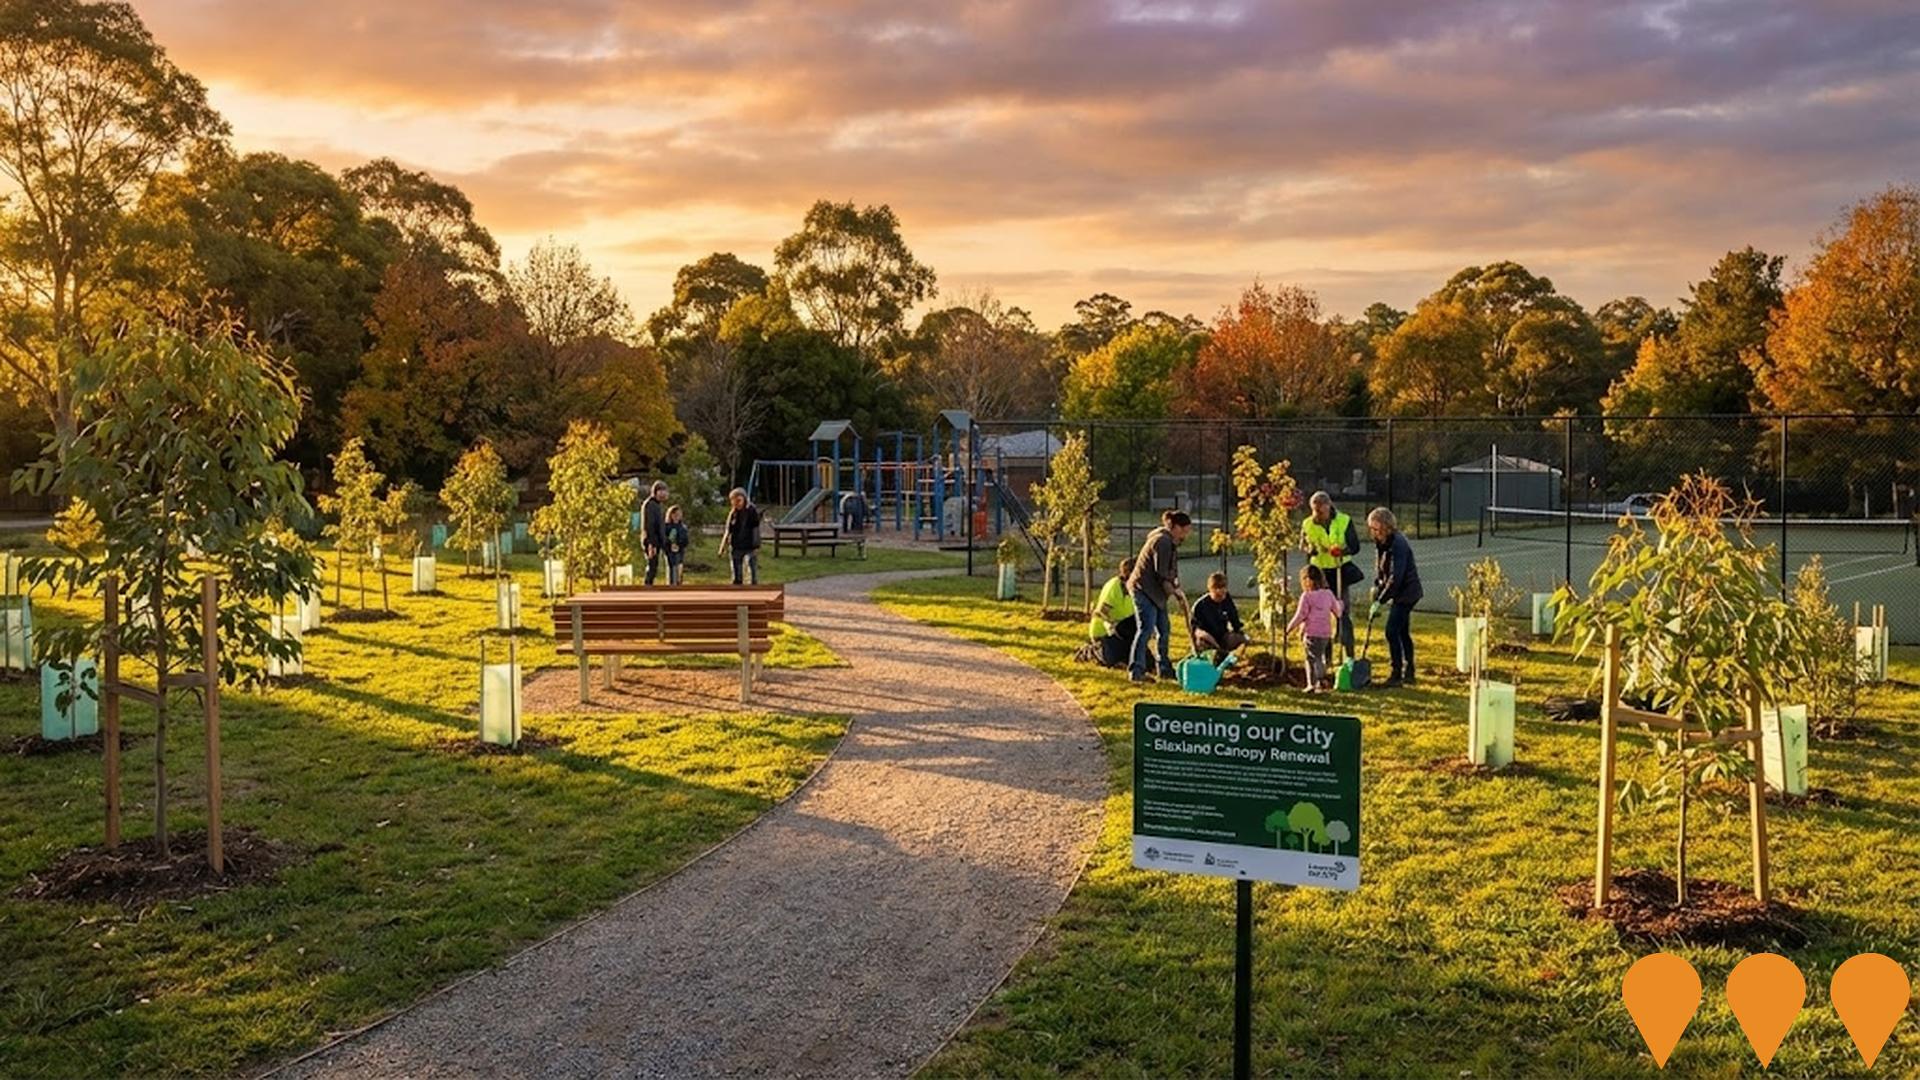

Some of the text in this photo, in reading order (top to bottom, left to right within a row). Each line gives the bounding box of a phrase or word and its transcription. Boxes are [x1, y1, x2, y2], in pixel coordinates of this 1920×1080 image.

[1144, 713, 1335, 749] Greening our City
[1214, 743, 1266, 762] Canopy
[1270, 748, 1330, 765] Renewal
